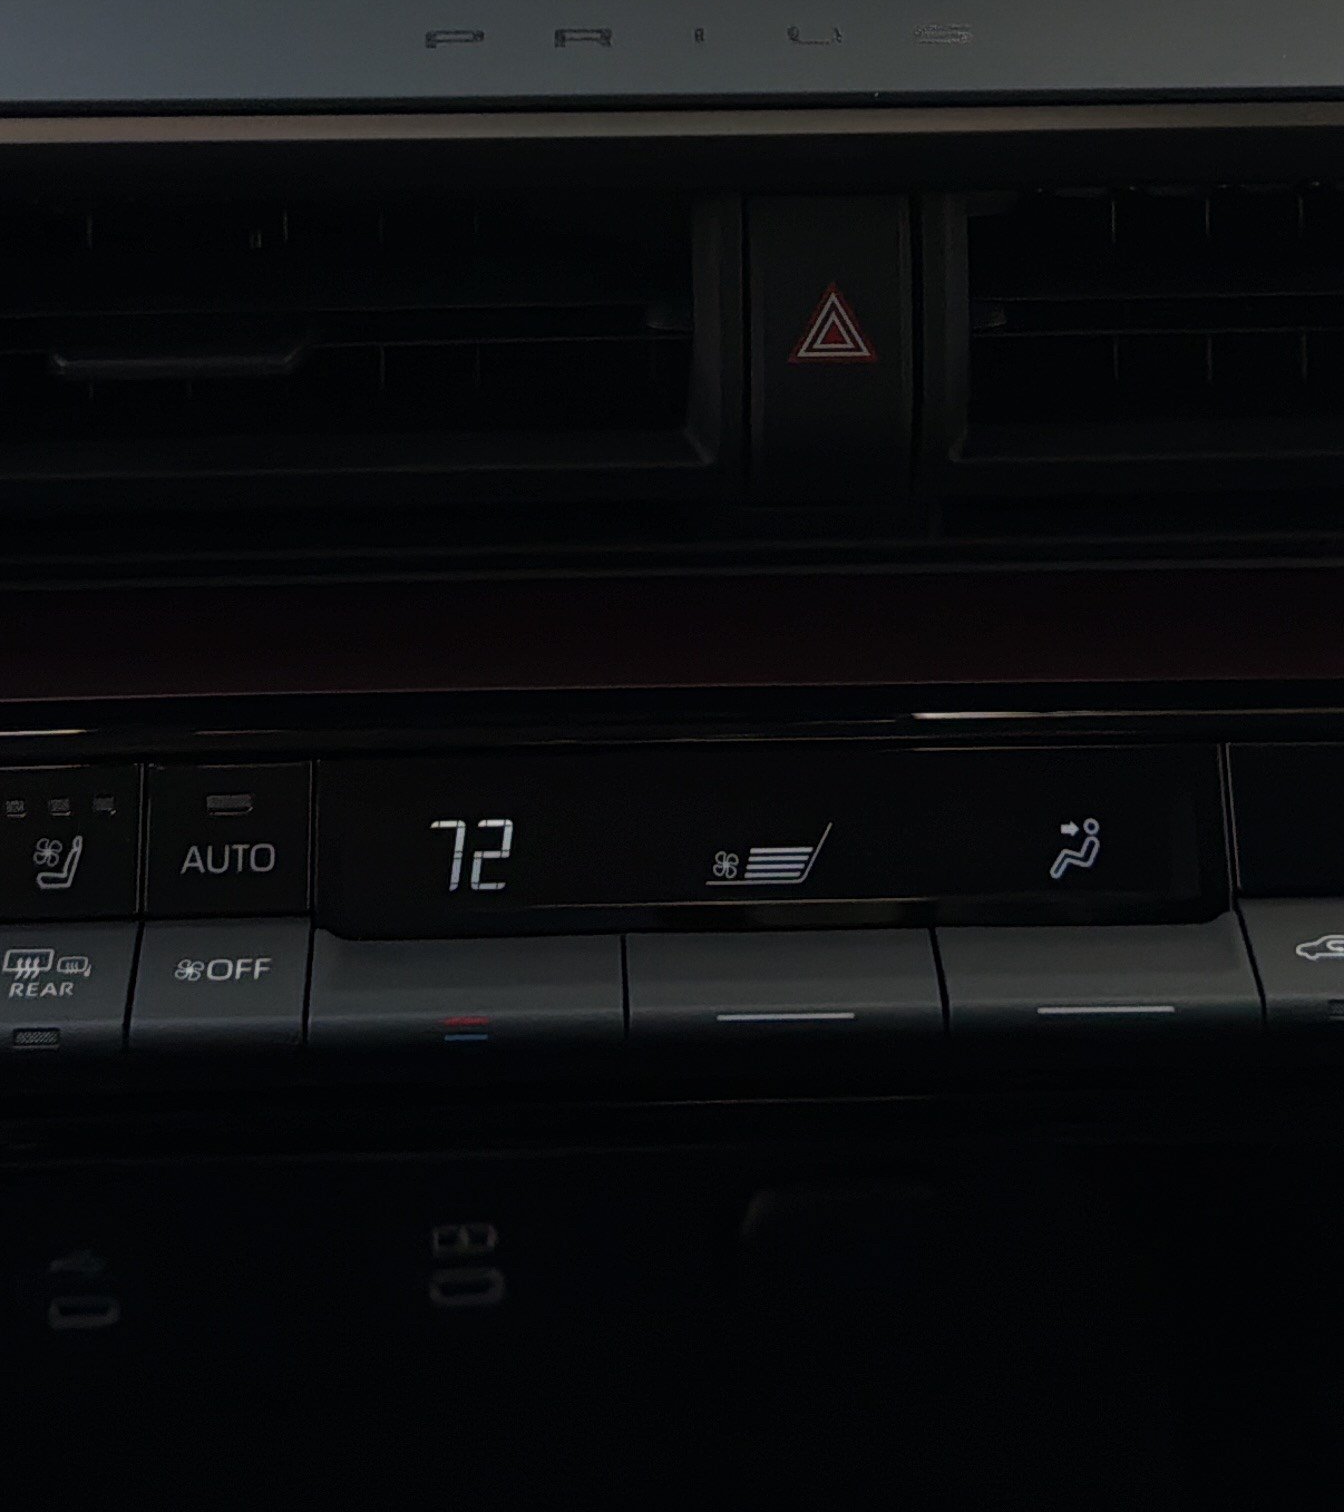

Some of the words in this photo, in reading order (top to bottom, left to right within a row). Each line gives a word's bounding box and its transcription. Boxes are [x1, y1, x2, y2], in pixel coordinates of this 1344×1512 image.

[181, 844, 276, 875] AUTO
[430, 818, 514, 891] 72
[206, 957, 272, 981] OFF
[8, 981, 74, 998] REAR
